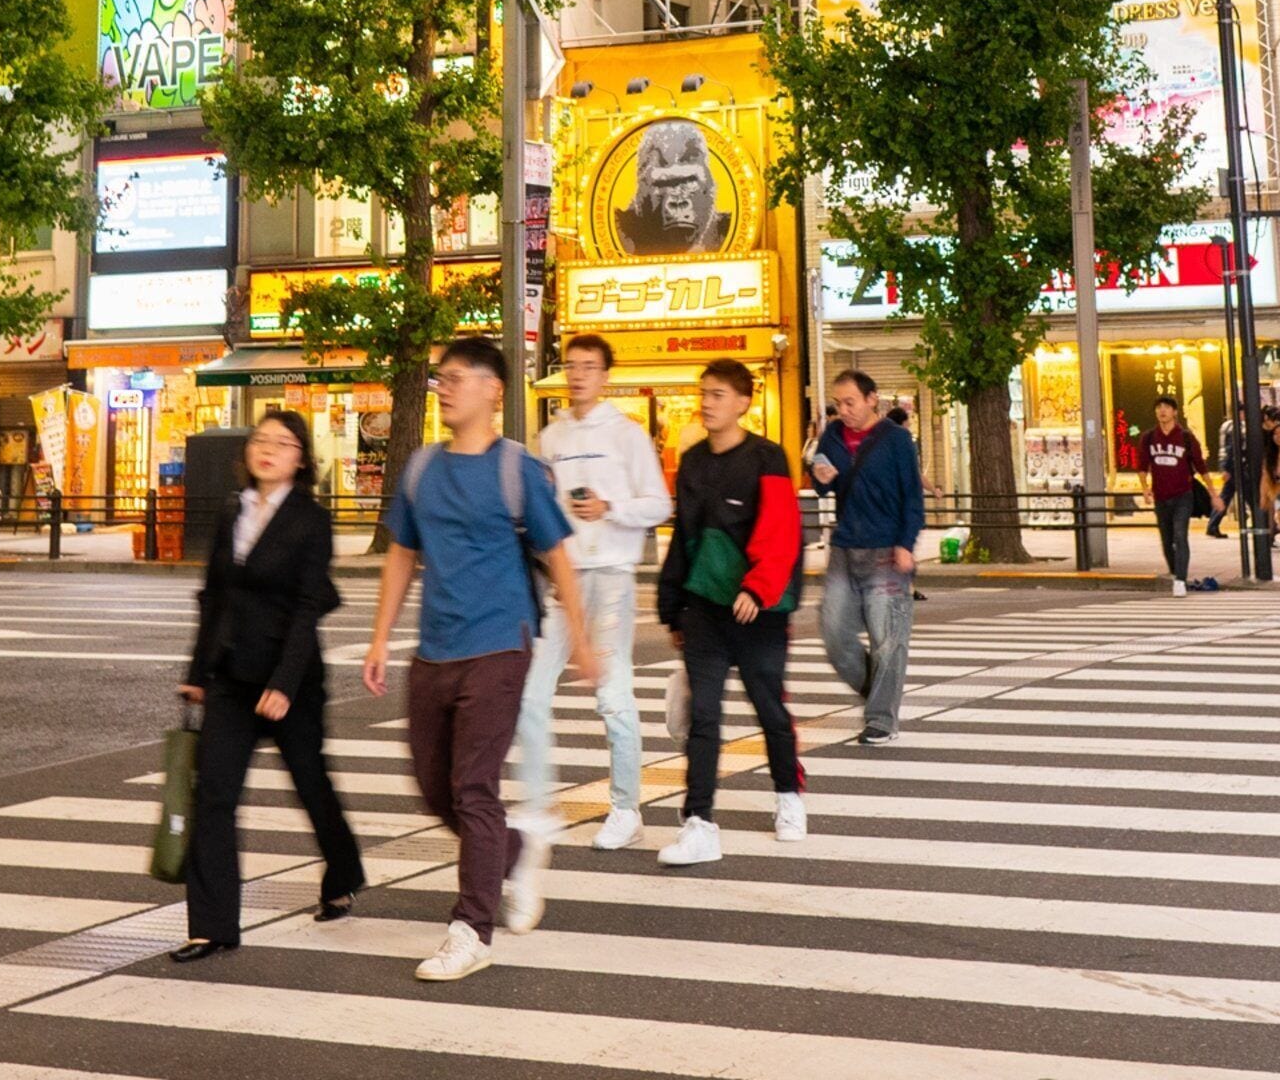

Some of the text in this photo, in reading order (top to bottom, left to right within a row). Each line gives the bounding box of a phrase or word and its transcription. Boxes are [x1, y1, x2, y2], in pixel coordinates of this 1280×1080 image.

[1112, 0, 1180, 21] DRESS
[113, 35, 224, 90] VAPE
[328, 216, 363, 240] 2階
[574, 276, 759, 315] ゴーゴーカレー
[249, 372, 308, 385] YOSHINOYA
[357, 451, 387, 464] 牛カル
